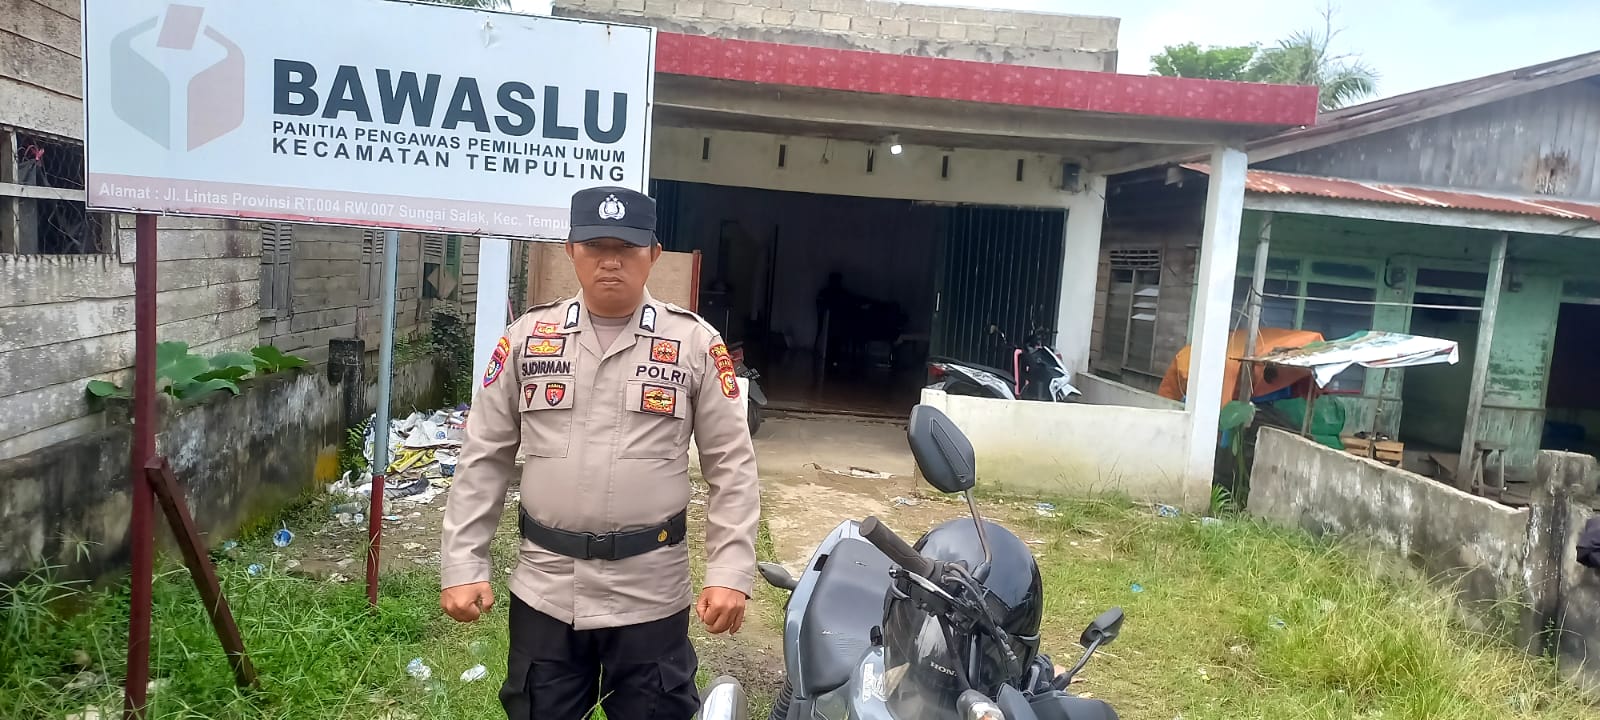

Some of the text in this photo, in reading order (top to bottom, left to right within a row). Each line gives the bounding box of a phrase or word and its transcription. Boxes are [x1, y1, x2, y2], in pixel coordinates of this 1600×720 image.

[273, 59, 628, 144] BAWASLU
[272, 137, 624, 182] KECAMATAN TEMPULING
[273, 120, 625, 163] PANITIA PENGAWAS PEMILIHAN UMUM
[99, 182, 151, 199] Alamat
[185, 190, 228, 204] Lintas
[232, 192, 290, 209] Provinsi
[294, 196, 340, 212] RT.004
[344, 201, 394, 217] RW.007
[399, 205, 447, 223] Sungai
[450, 208, 489, 225] Salak,
[494, 212, 521, 226] Kec.
[526, 213, 569, 231] Tempu
[521, 360, 571, 377] SUDIRMAN
[635, 365, 687, 384] POLRI
[930, 661, 958, 677] HON
